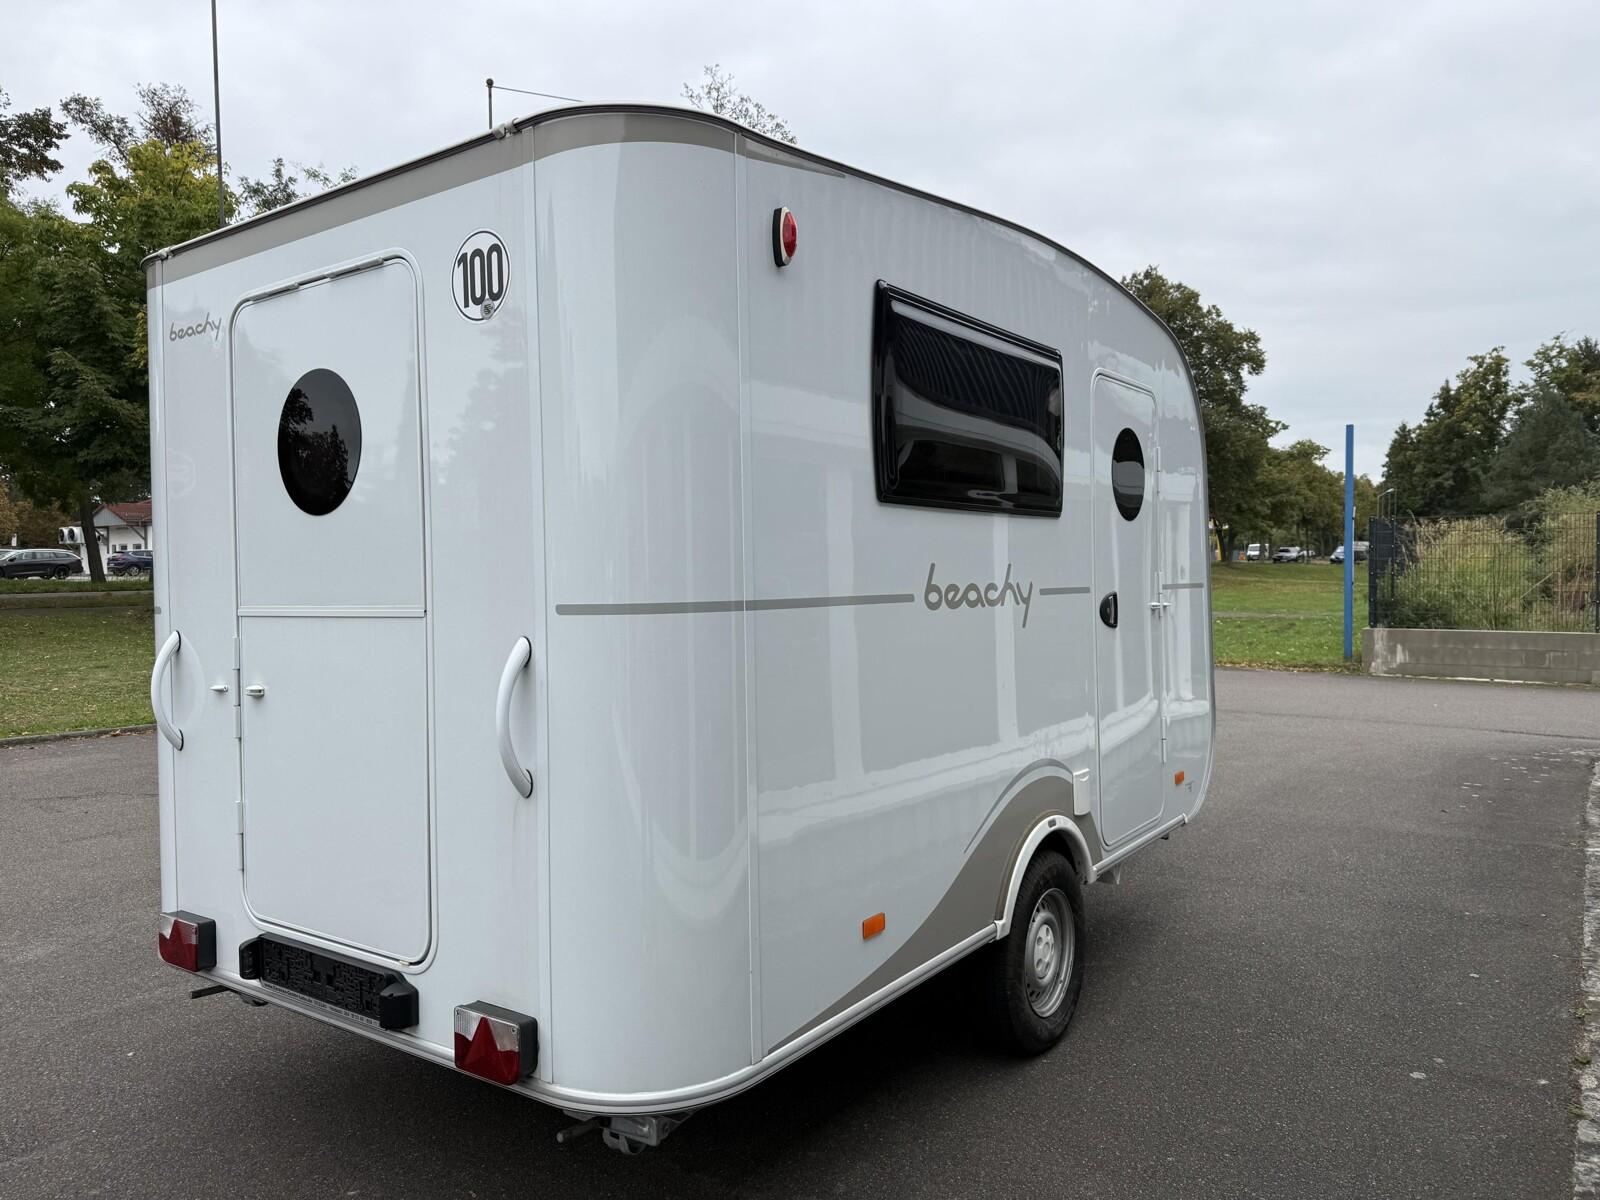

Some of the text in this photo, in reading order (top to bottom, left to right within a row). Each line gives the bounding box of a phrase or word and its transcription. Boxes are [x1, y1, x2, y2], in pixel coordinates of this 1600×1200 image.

[457, 243, 504, 309] 100
[169, 312, 222, 341] beachy
[924, 563, 1033, 628] beachy
